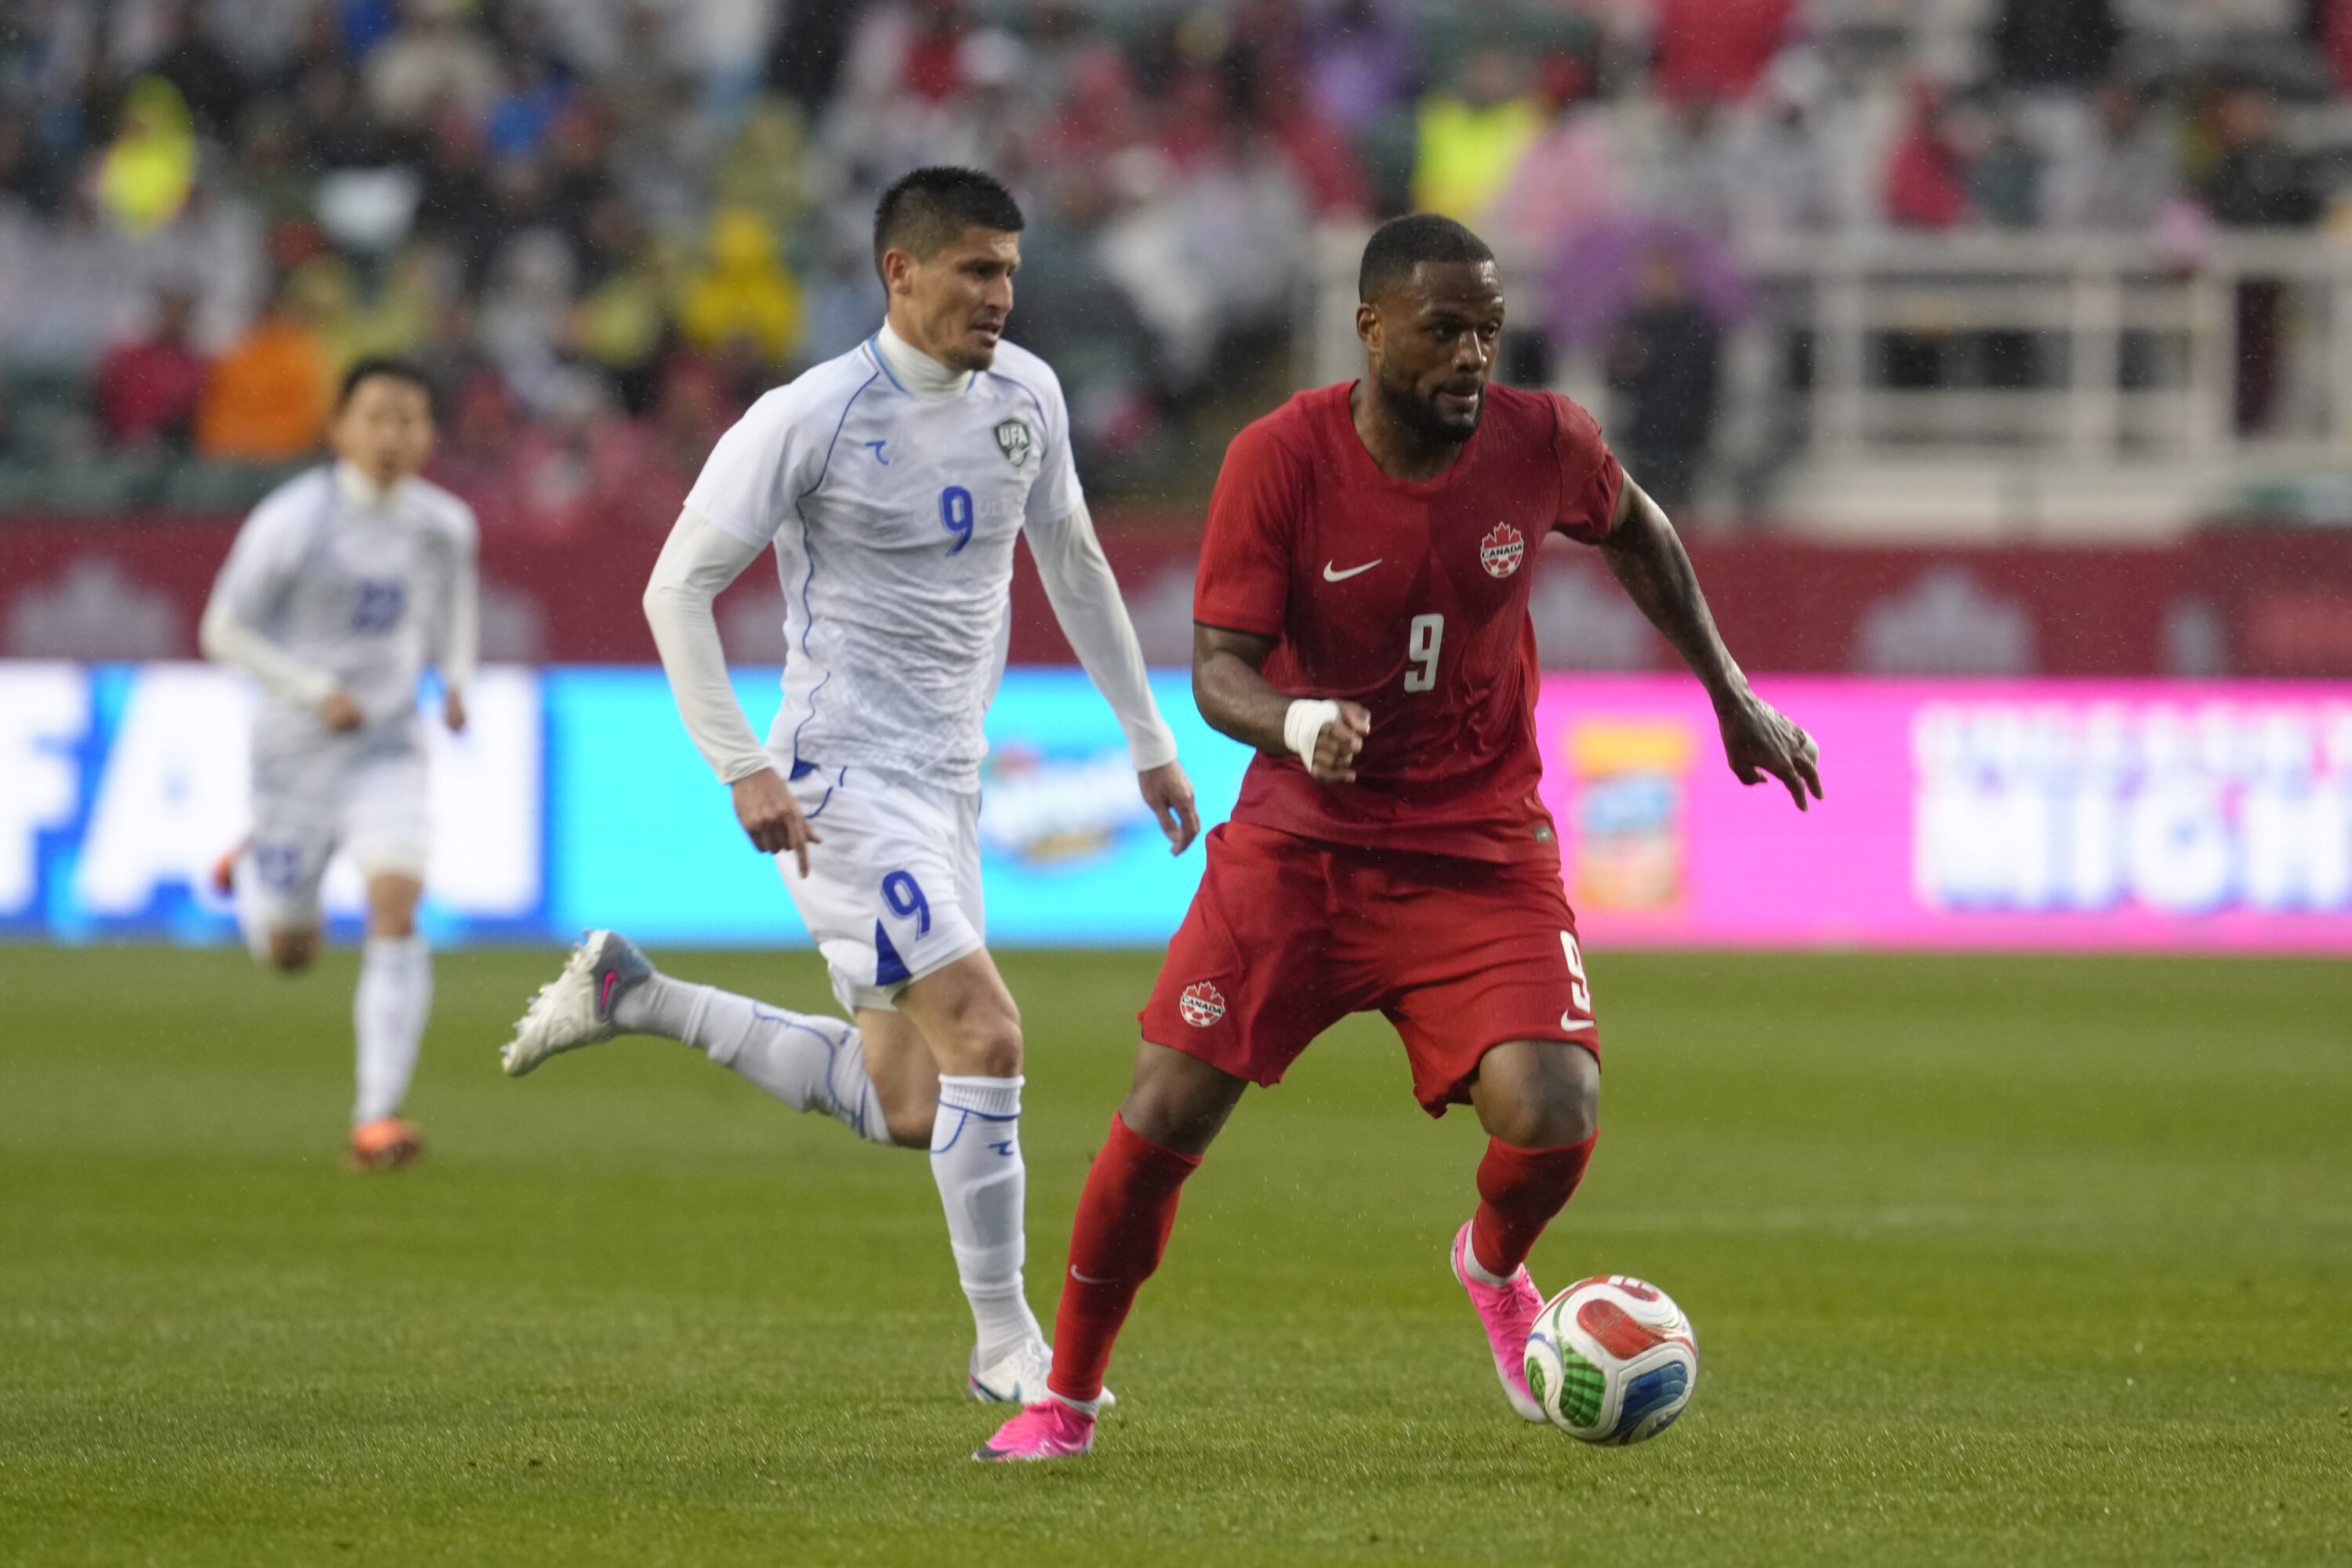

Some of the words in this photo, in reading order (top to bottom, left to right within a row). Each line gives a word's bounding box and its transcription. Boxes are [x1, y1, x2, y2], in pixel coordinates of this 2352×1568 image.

[1000, 425, 1029, 446] UFA
[939, 485, 974, 557] 9
[1481, 545, 1523, 558] CANADA
[1404, 613, 1444, 692] 9
[880, 869, 931, 941] 9
[1181, 996, 1221, 1014] CANADA
[1560, 930, 1591, 1014] 9
